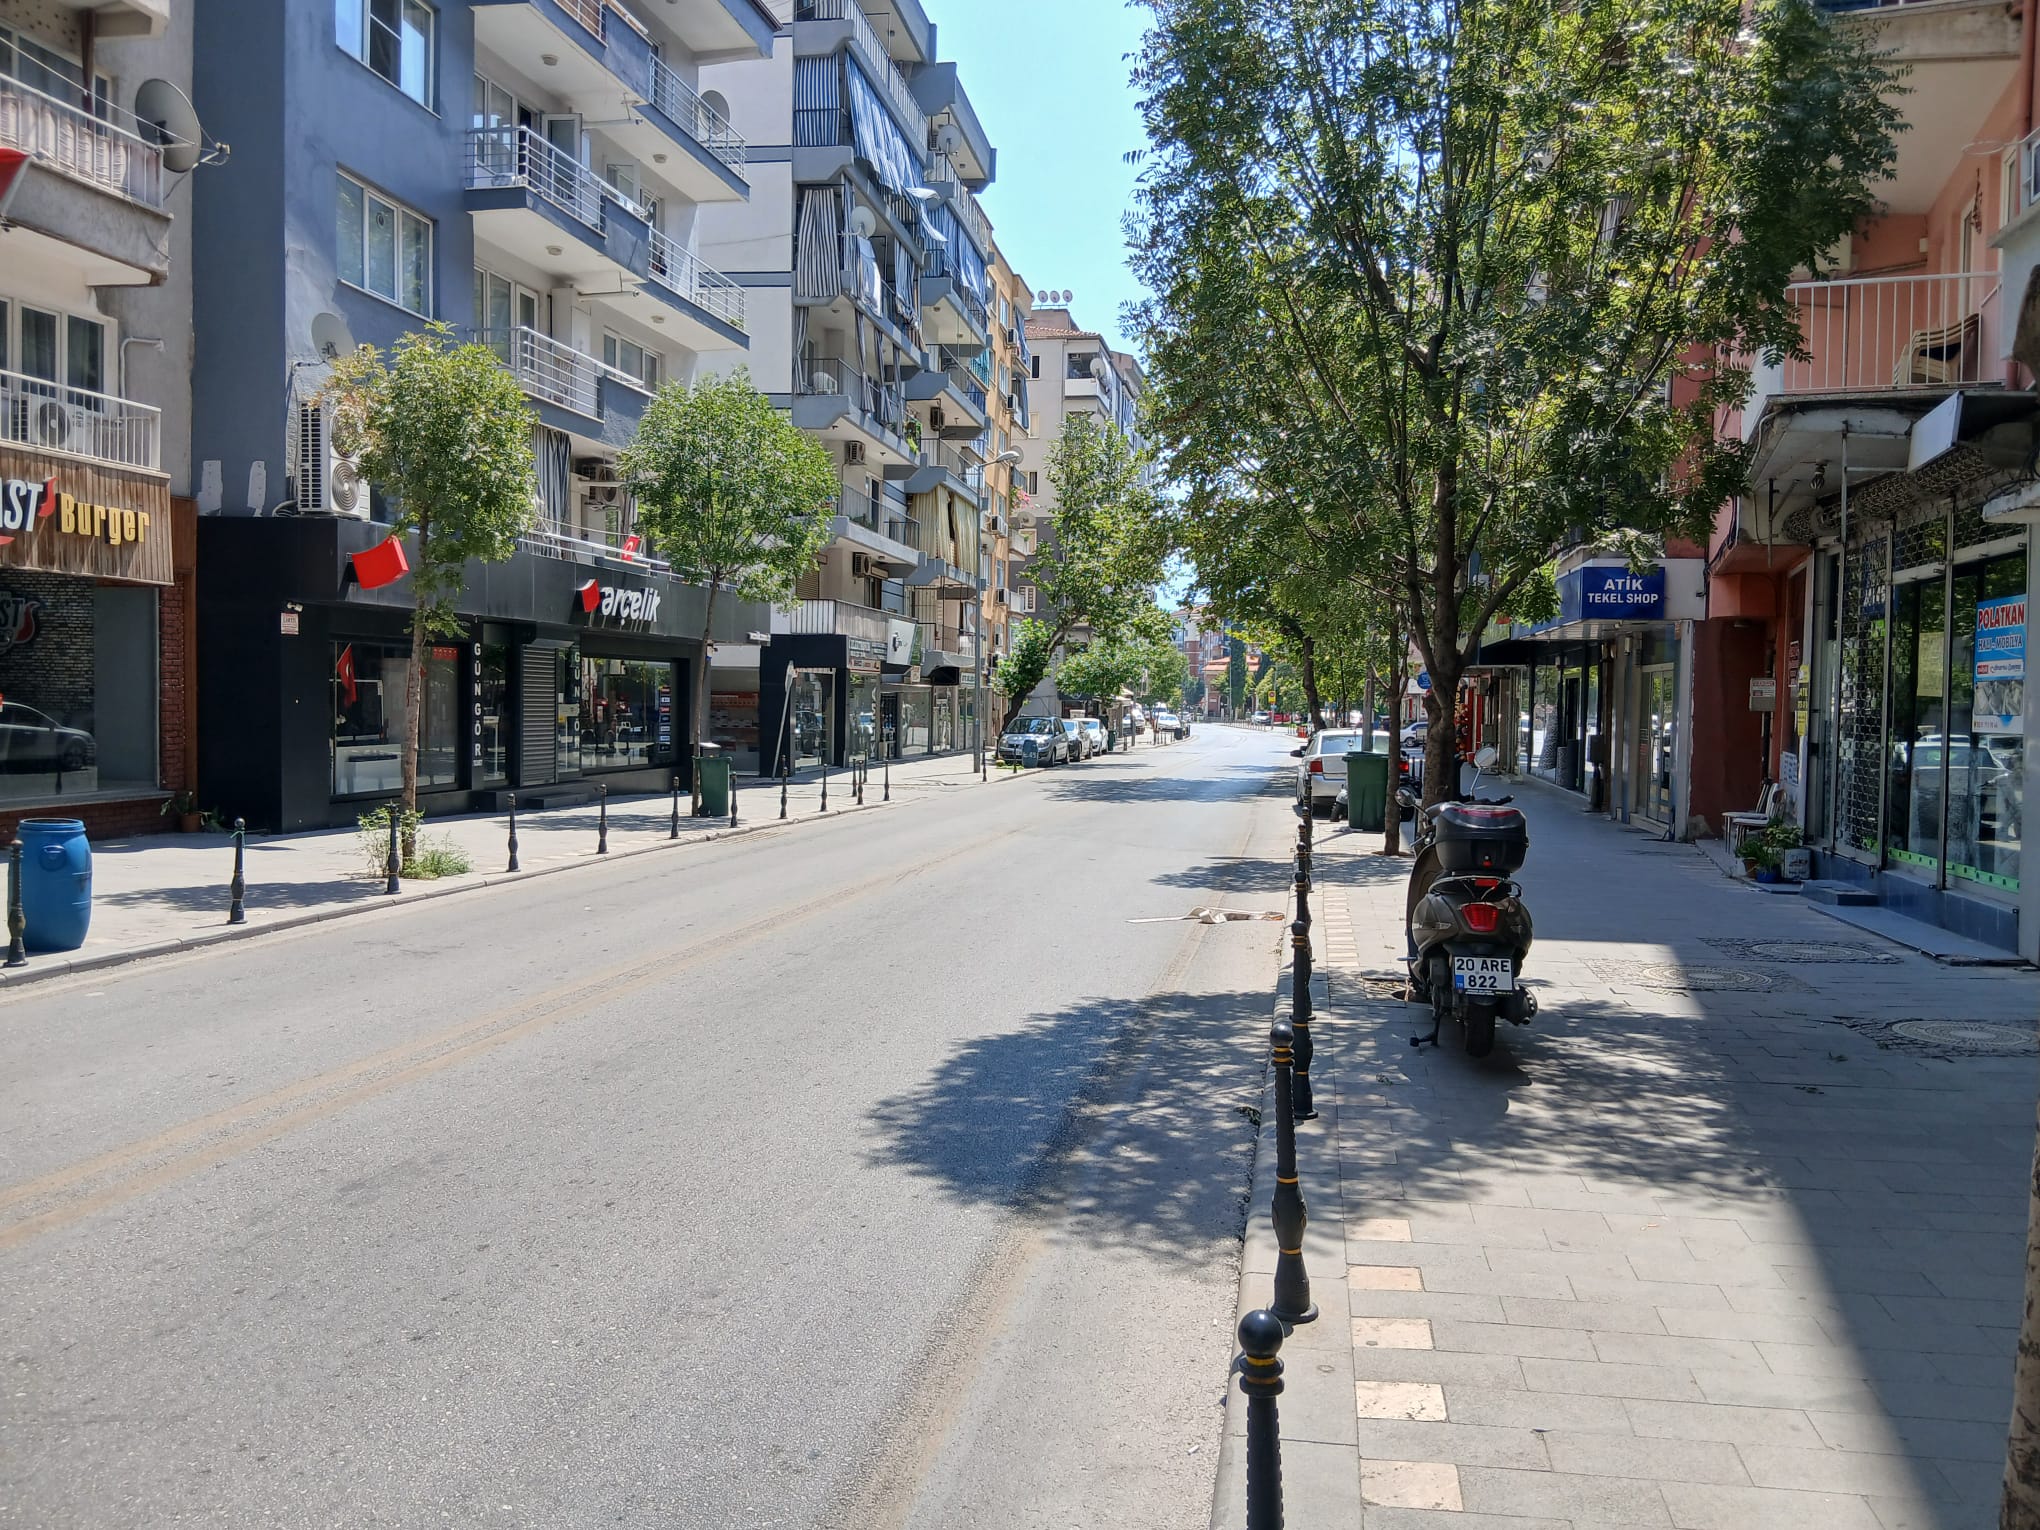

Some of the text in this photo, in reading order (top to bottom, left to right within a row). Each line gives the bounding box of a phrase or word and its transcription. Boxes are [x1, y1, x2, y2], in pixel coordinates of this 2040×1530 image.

[0, 478, 150, 546] ST Burger
[1604, 576, 1643, 590] ATİK
[1587, 593, 1659, 604] TEKEL SHOP
[600, 586, 661, 626] arçelik
[1977, 602, 2025, 630] POLATKAN
[1456, 959, 1509, 972] 20 ARE
[1468, 975, 1497, 988] 822
